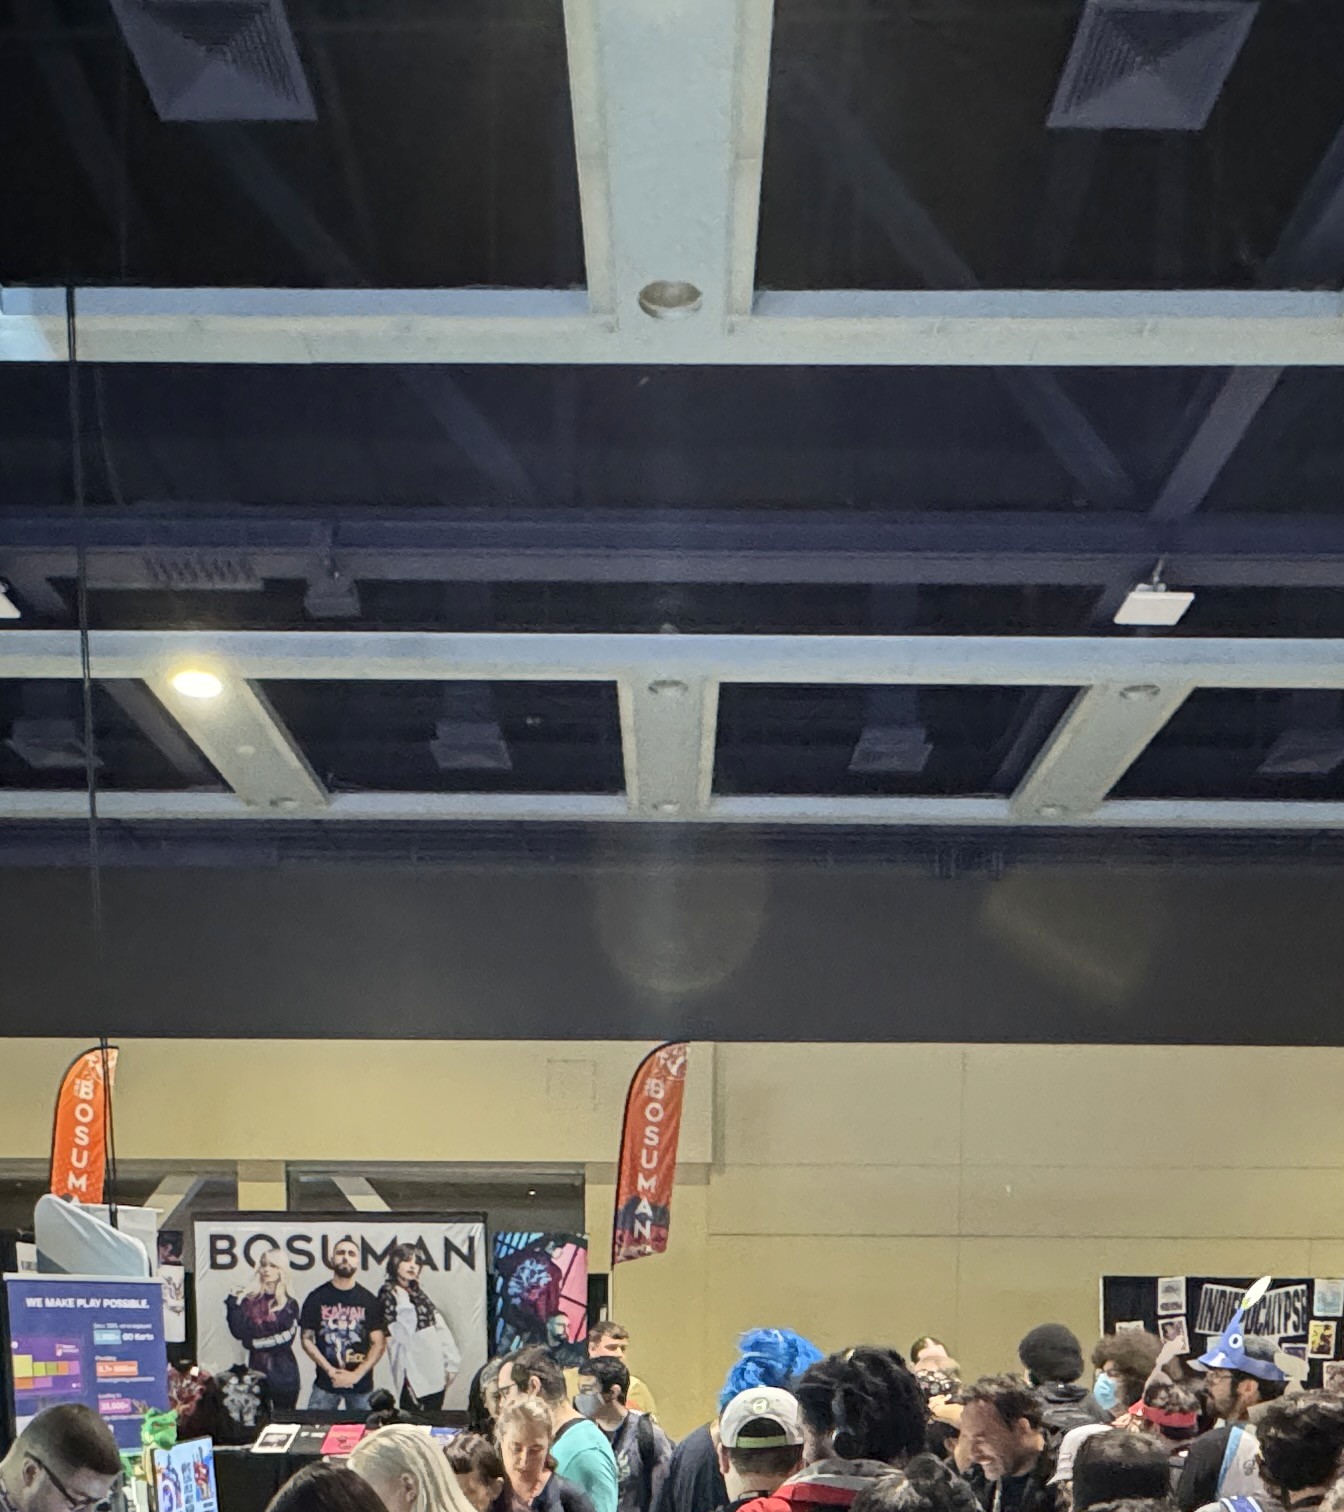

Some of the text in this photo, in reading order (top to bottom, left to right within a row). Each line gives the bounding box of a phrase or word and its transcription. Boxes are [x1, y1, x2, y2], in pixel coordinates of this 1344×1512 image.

[633, 1079, 664, 1239] BOSUMAN
[25, 1297, 43, 1308] WE
[45, 1297, 75, 1308] MAKE
[77, 1298, 101, 1309] PLAY
